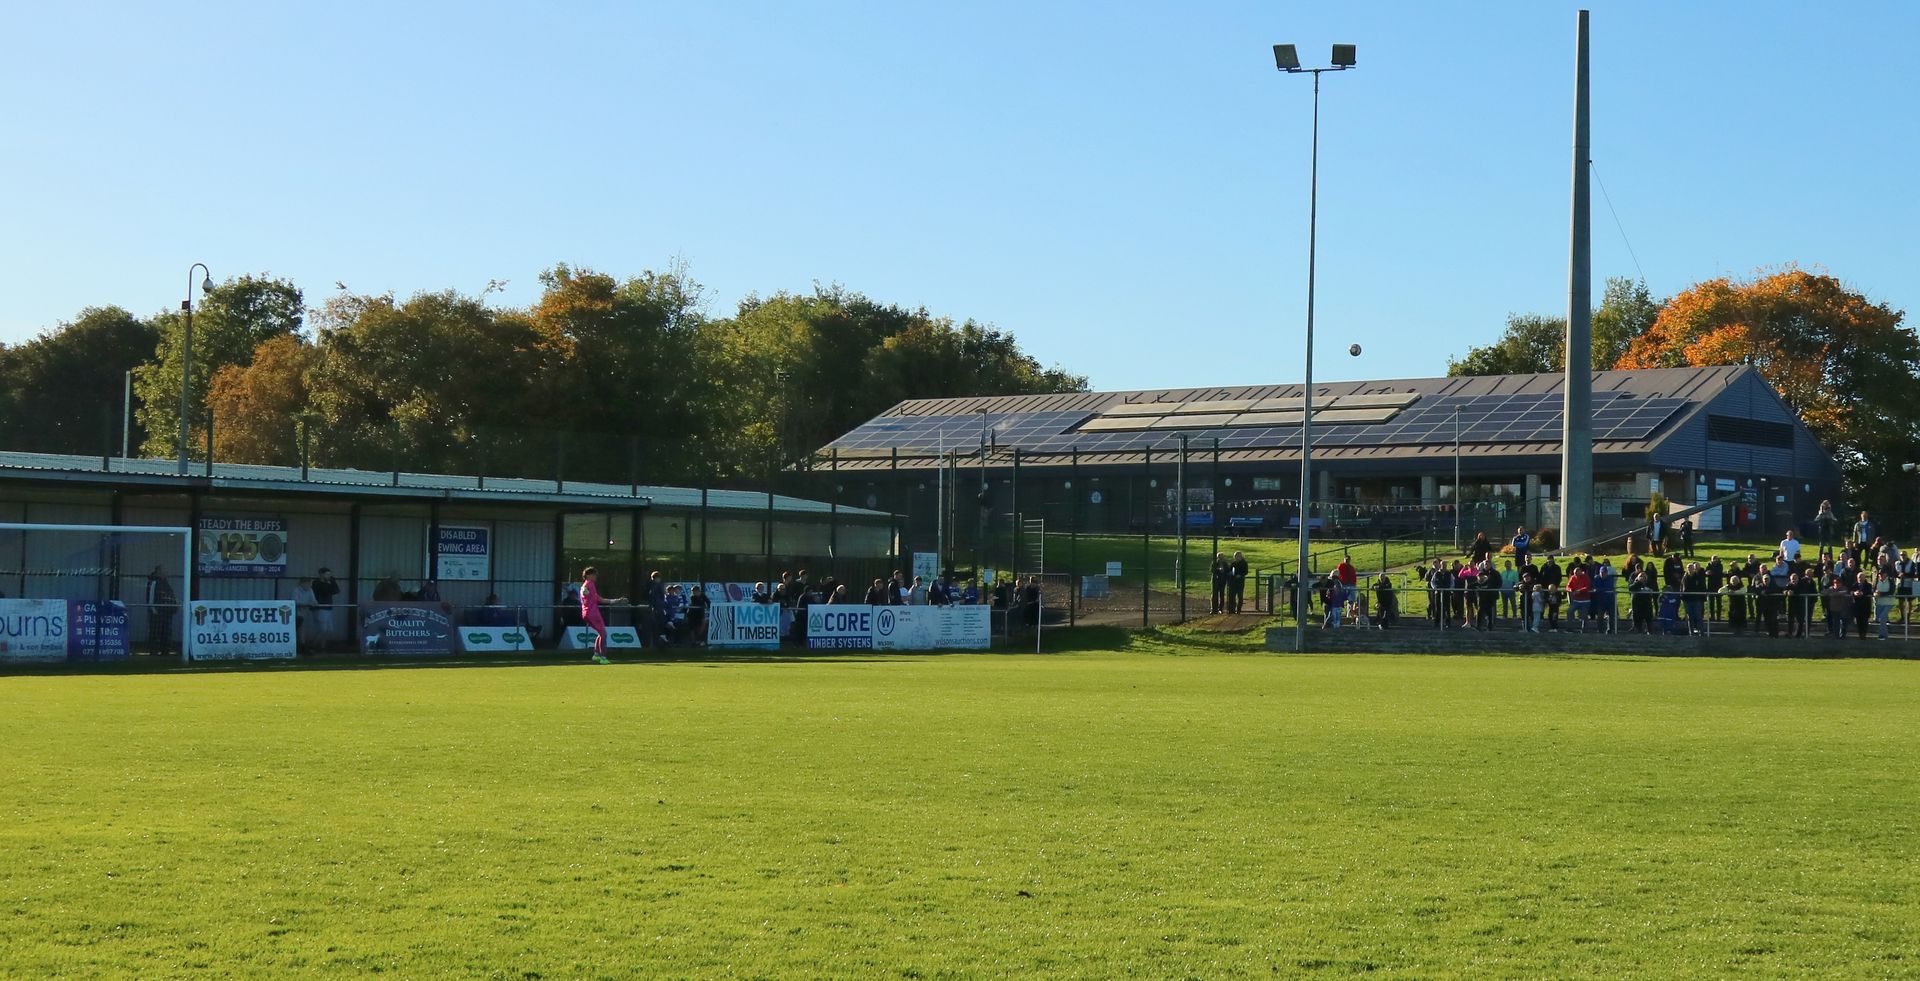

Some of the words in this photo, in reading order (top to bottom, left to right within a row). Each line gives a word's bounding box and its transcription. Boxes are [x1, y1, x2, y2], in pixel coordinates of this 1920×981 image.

[234, 520, 252, 530] THE
[254, 520, 281, 531] BUFFS
[440, 530, 477, 540] DISABLED
[219, 533, 257, 561] 125
[438, 543, 464, 553] EWING
[465, 544, 486, 554] AREA
[83, 603, 97, 612] GA
[209, 607, 278, 624] TOUGH
[736, 606, 778, 625] MGM
[388, 619, 426, 629] QUALITY
[824, 612, 871, 632] CORE
[85, 626, 119, 636] HETING
[385, 629, 431, 637] BUTCHERS
[736, 626, 778, 640] TIMBER
[197, 633, 228, 645] 0141
[231, 632, 256, 644] 954
[259, 632, 290, 643] 8015
[809, 638, 836, 649] TIMBER
[837, 638, 872, 648] SYSTEMS
